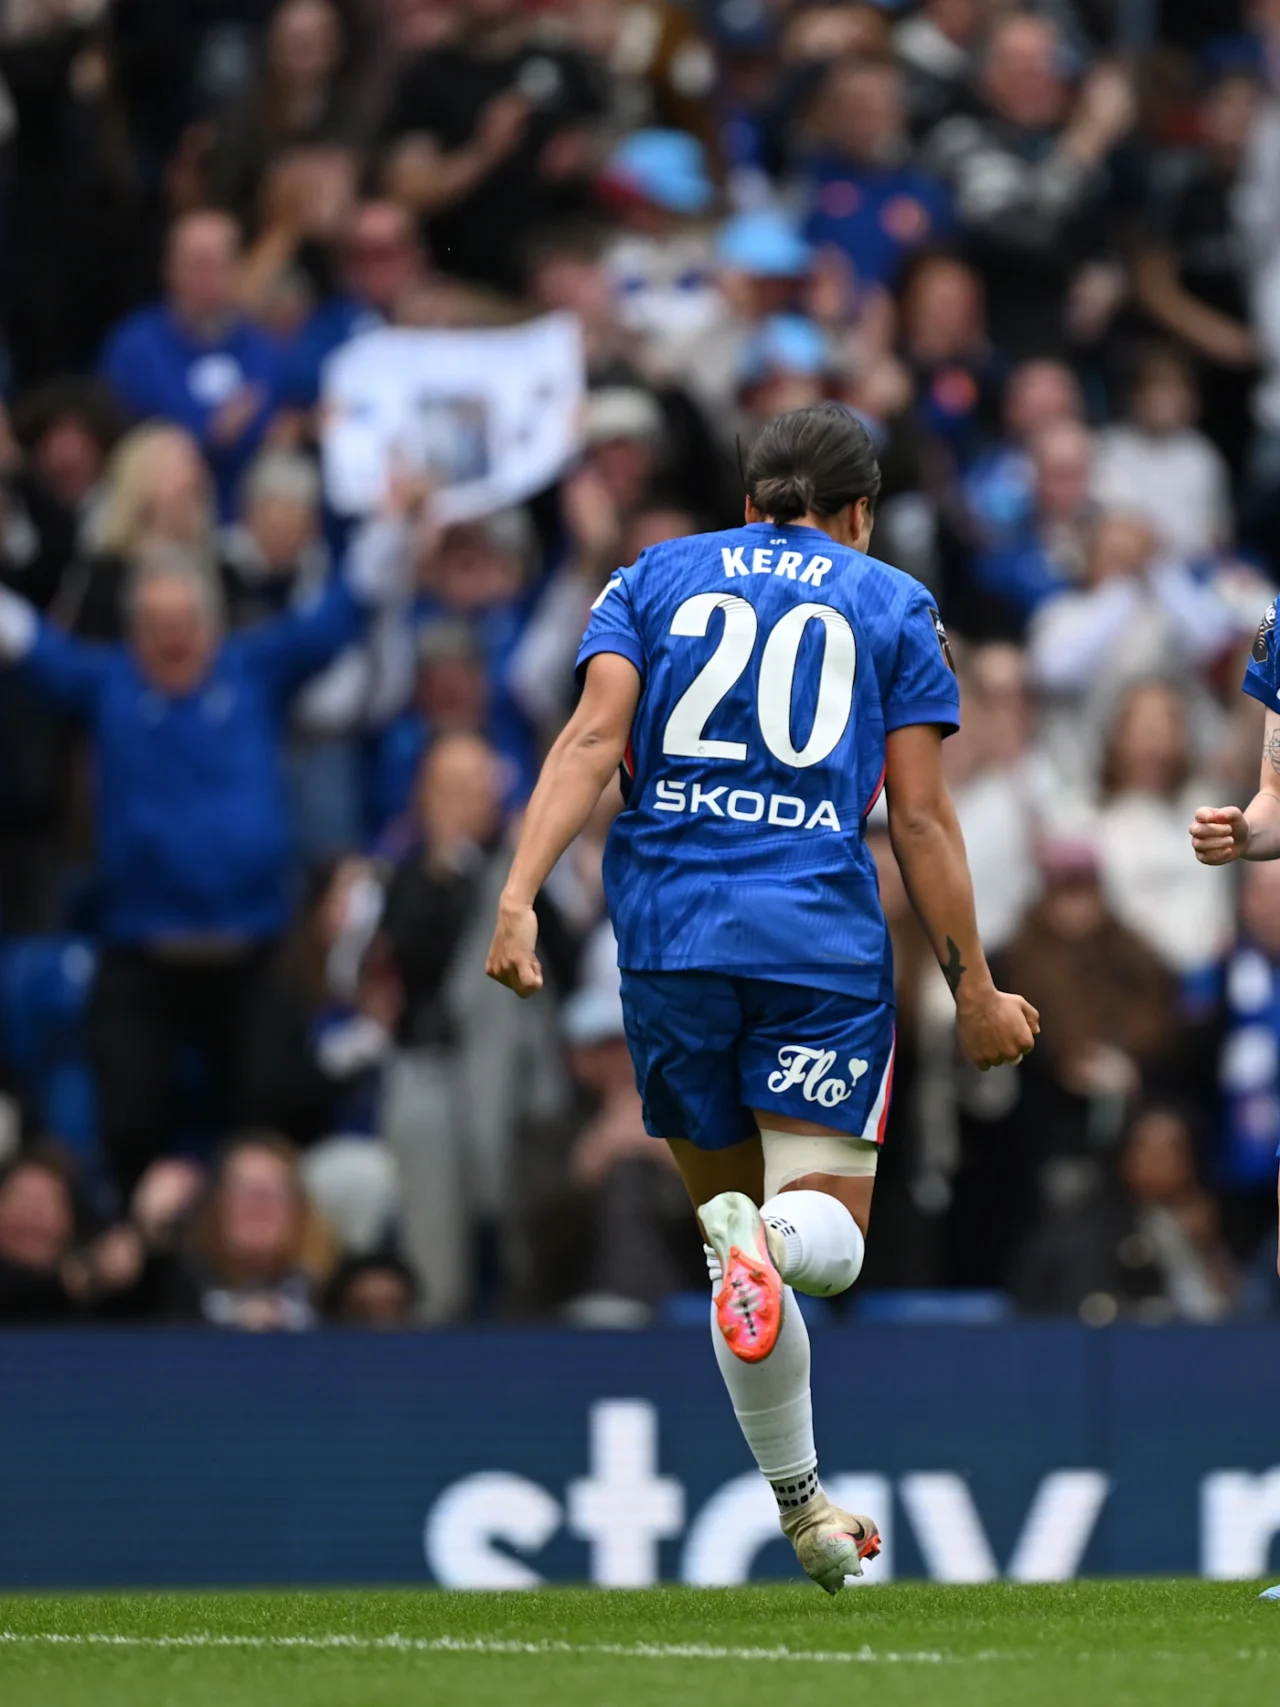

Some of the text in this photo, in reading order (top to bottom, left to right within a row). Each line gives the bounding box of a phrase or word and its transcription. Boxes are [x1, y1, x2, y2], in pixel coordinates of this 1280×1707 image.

[721, 547, 833, 587] KERR
[662, 591, 857, 769] 20
[767, 1045, 853, 1108] Flo
